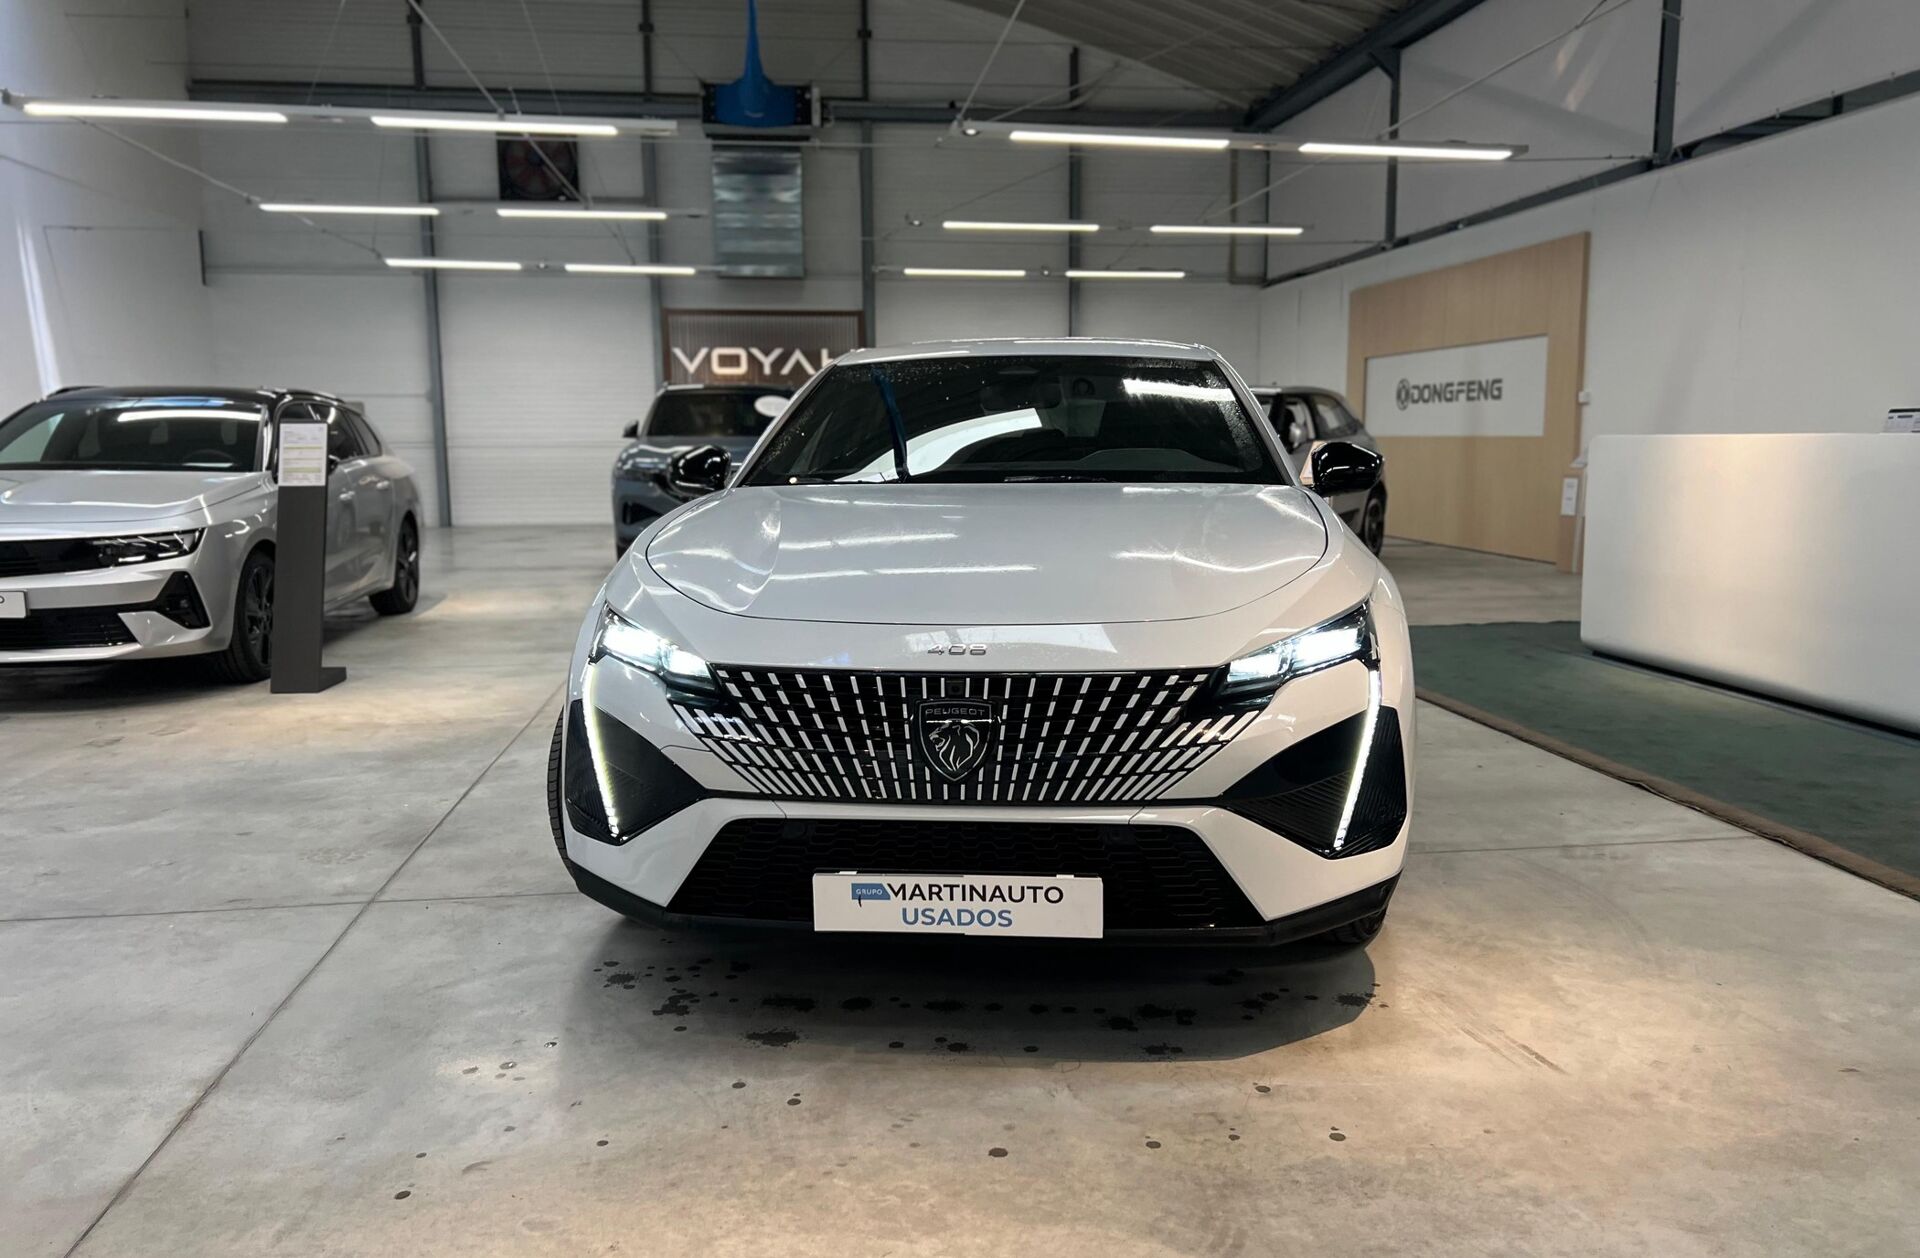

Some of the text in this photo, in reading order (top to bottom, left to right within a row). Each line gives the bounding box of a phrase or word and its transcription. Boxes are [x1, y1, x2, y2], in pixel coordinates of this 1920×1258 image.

[1410, 379, 1503, 404] DONGFENG
[927, 643, 987, 656] 408
[925, 707, 986, 716] PEUGEOT
[855, 882, 1064, 904] GRUPO MARTINAUTO
[902, 907, 1013, 928] USADOS
